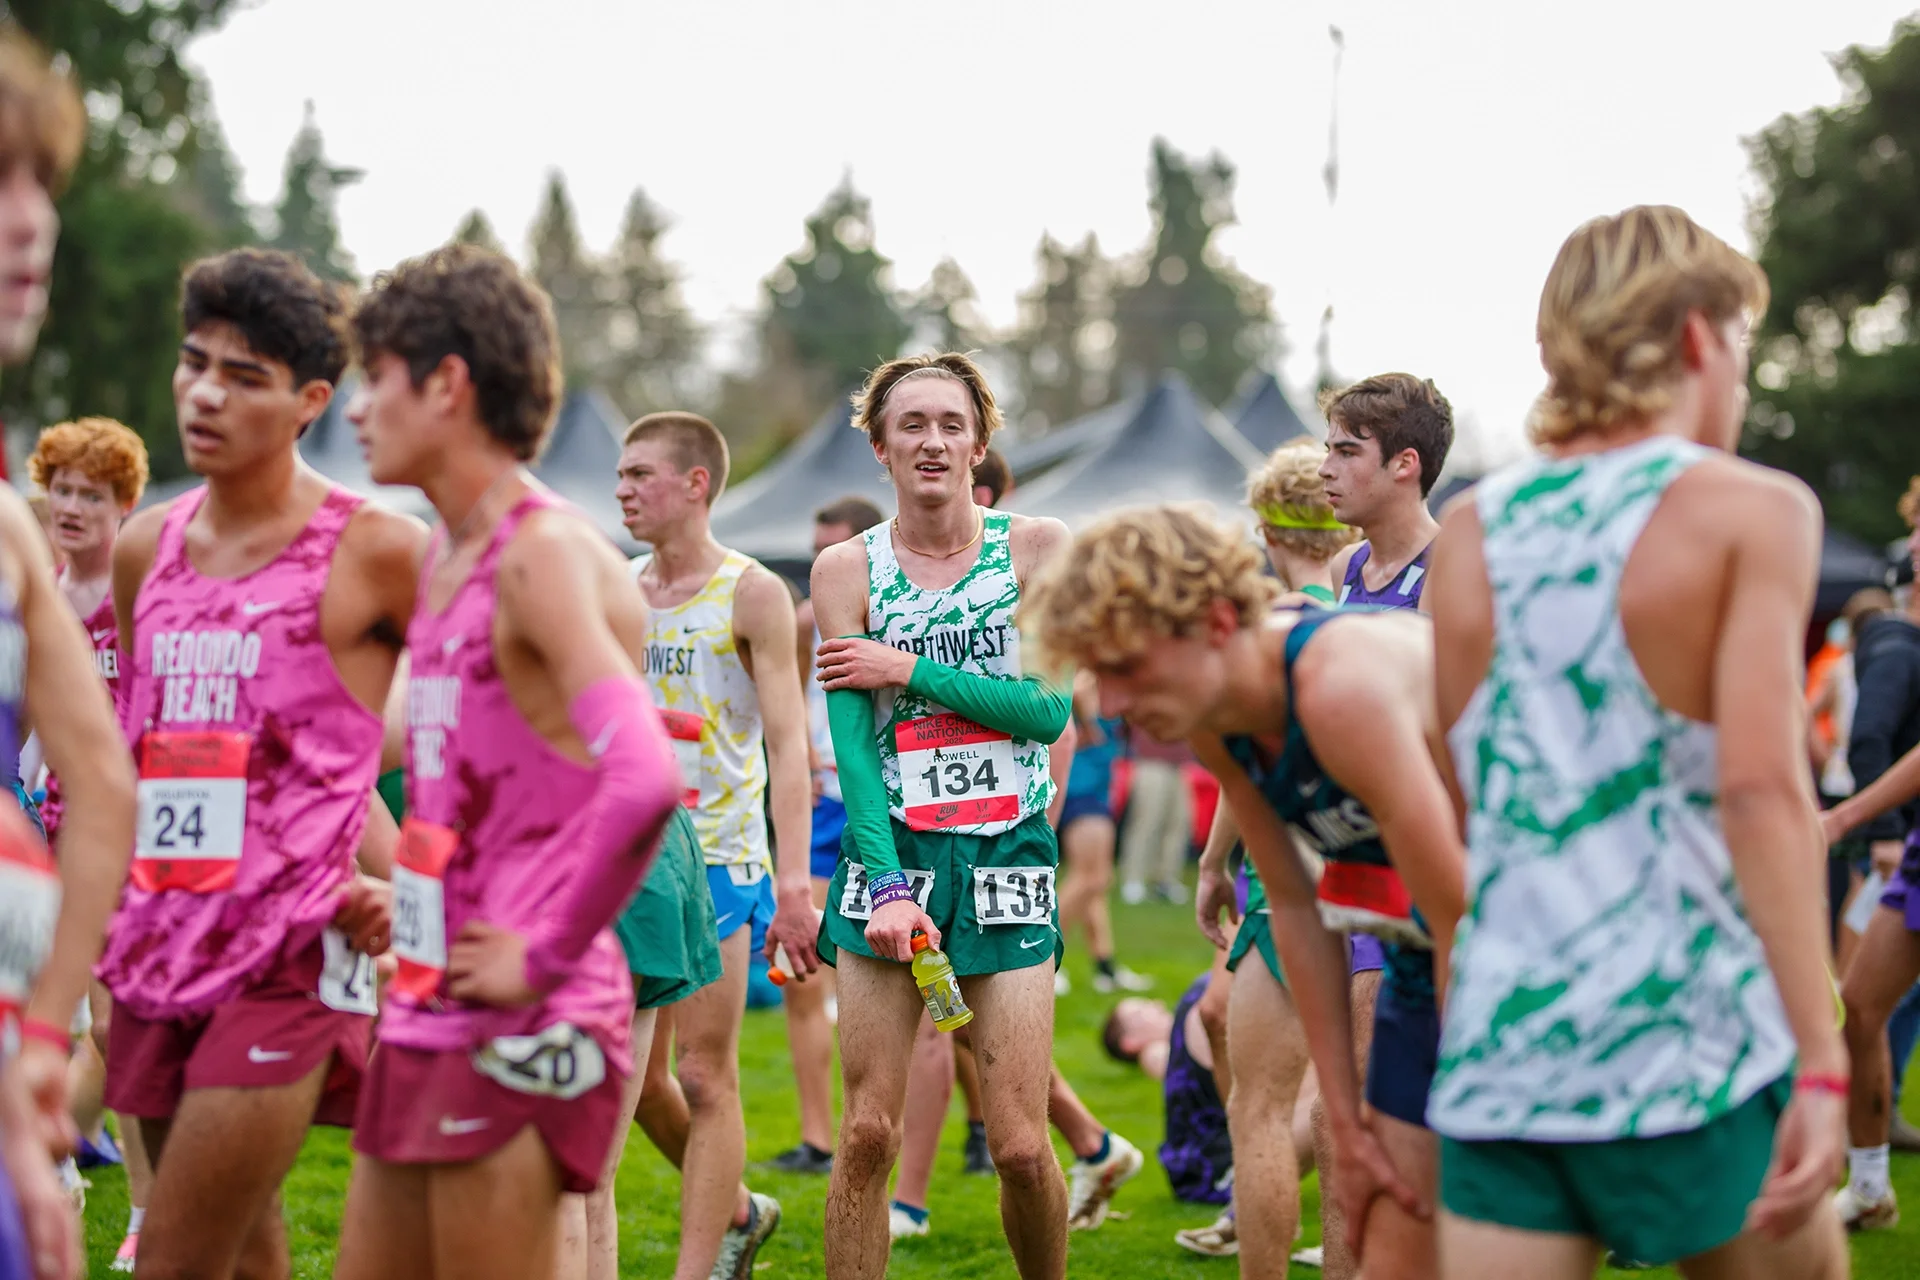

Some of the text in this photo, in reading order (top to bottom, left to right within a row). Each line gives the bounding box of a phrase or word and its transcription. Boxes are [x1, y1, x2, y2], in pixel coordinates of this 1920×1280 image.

[152, 629, 262, 679] REDONDO
[890, 624, 1007, 664] RTHWEST
[642, 646, 695, 676] DWEST
[161, 676, 238, 723] BEACH
[913, 715, 971, 730] NIKE CRO
[916, 724, 989, 741] NATIONALS
[945, 737, 964, 745] 2025
[933, 750, 980, 763] ROWELL
[921, 758, 999, 798] 134
[940, 804, 959, 815] RUN
[155, 804, 204, 848] 24
[873, 889, 912, 906] WON'T WIN
[983, 872, 1053, 918] 134
